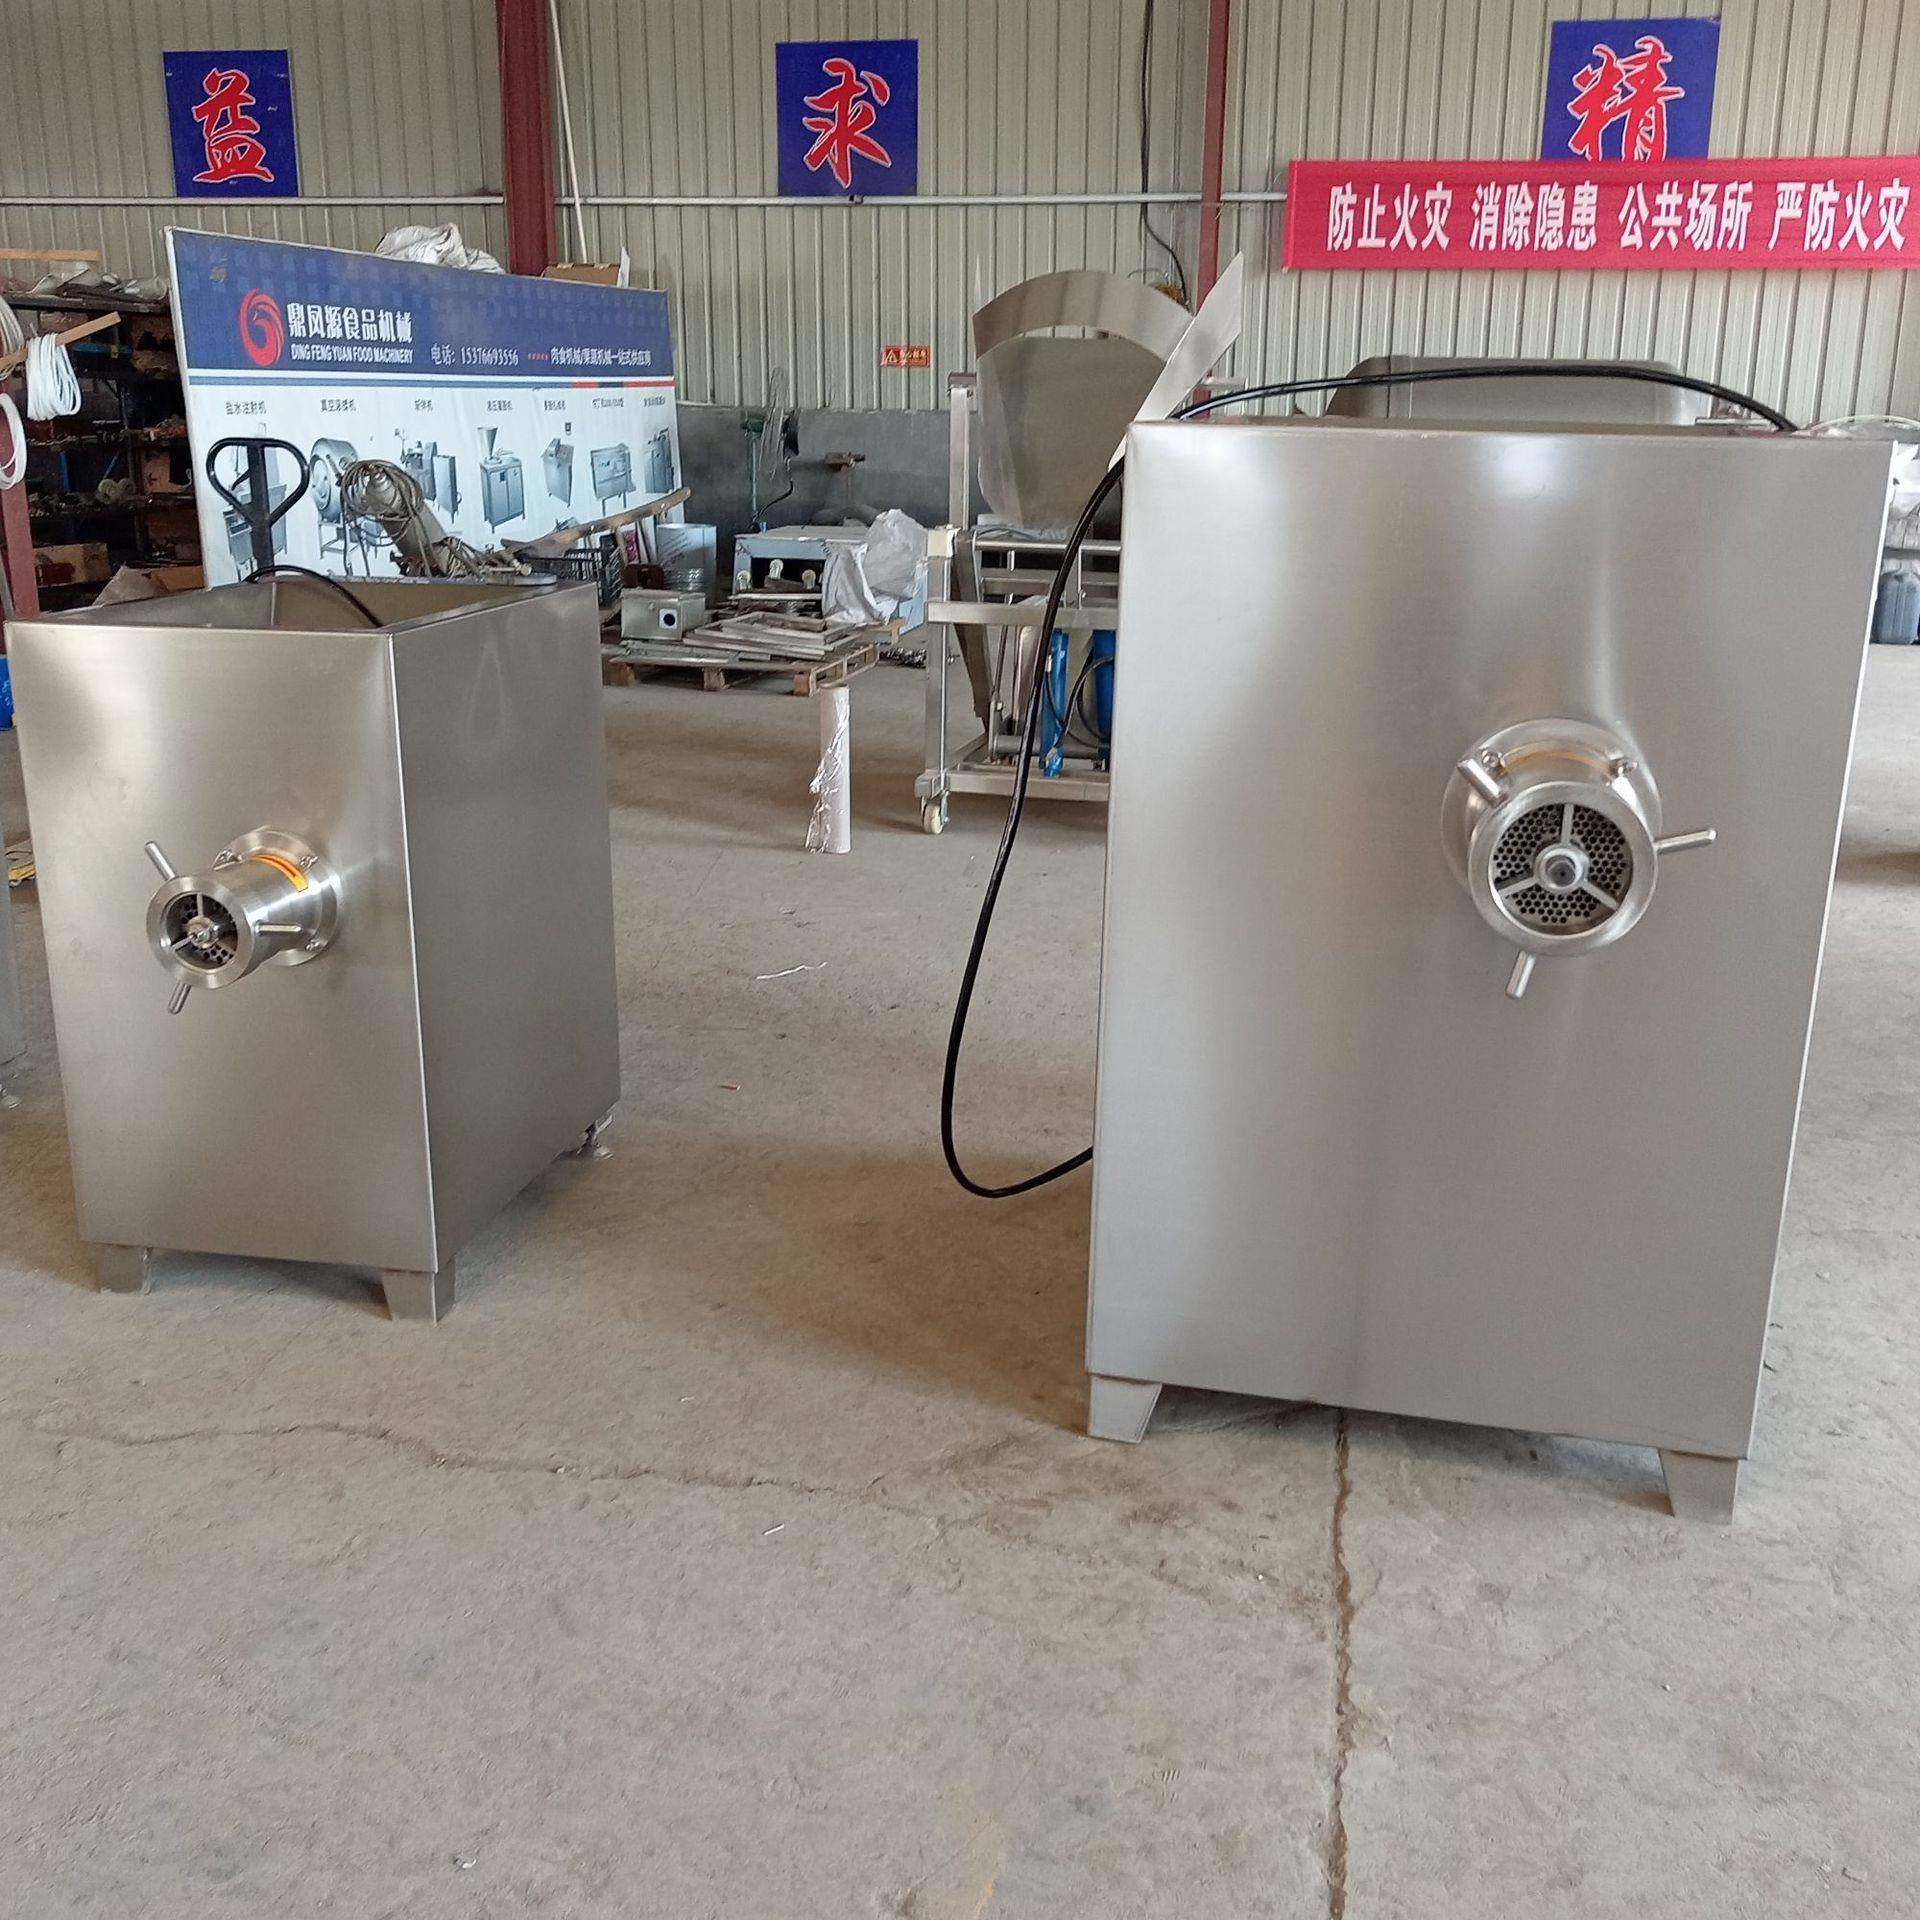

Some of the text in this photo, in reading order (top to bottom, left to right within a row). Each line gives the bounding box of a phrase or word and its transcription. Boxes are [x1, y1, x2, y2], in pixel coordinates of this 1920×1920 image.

[192, 68, 275, 183] 益
[1567, 35, 1685, 160] 精
[1325, 178, 1911, 252] 防止火灾 消除隐患 公共场所 严防火灾
[290, 343, 413, 364] DING FENG YUAN FOOD MACHINERY
